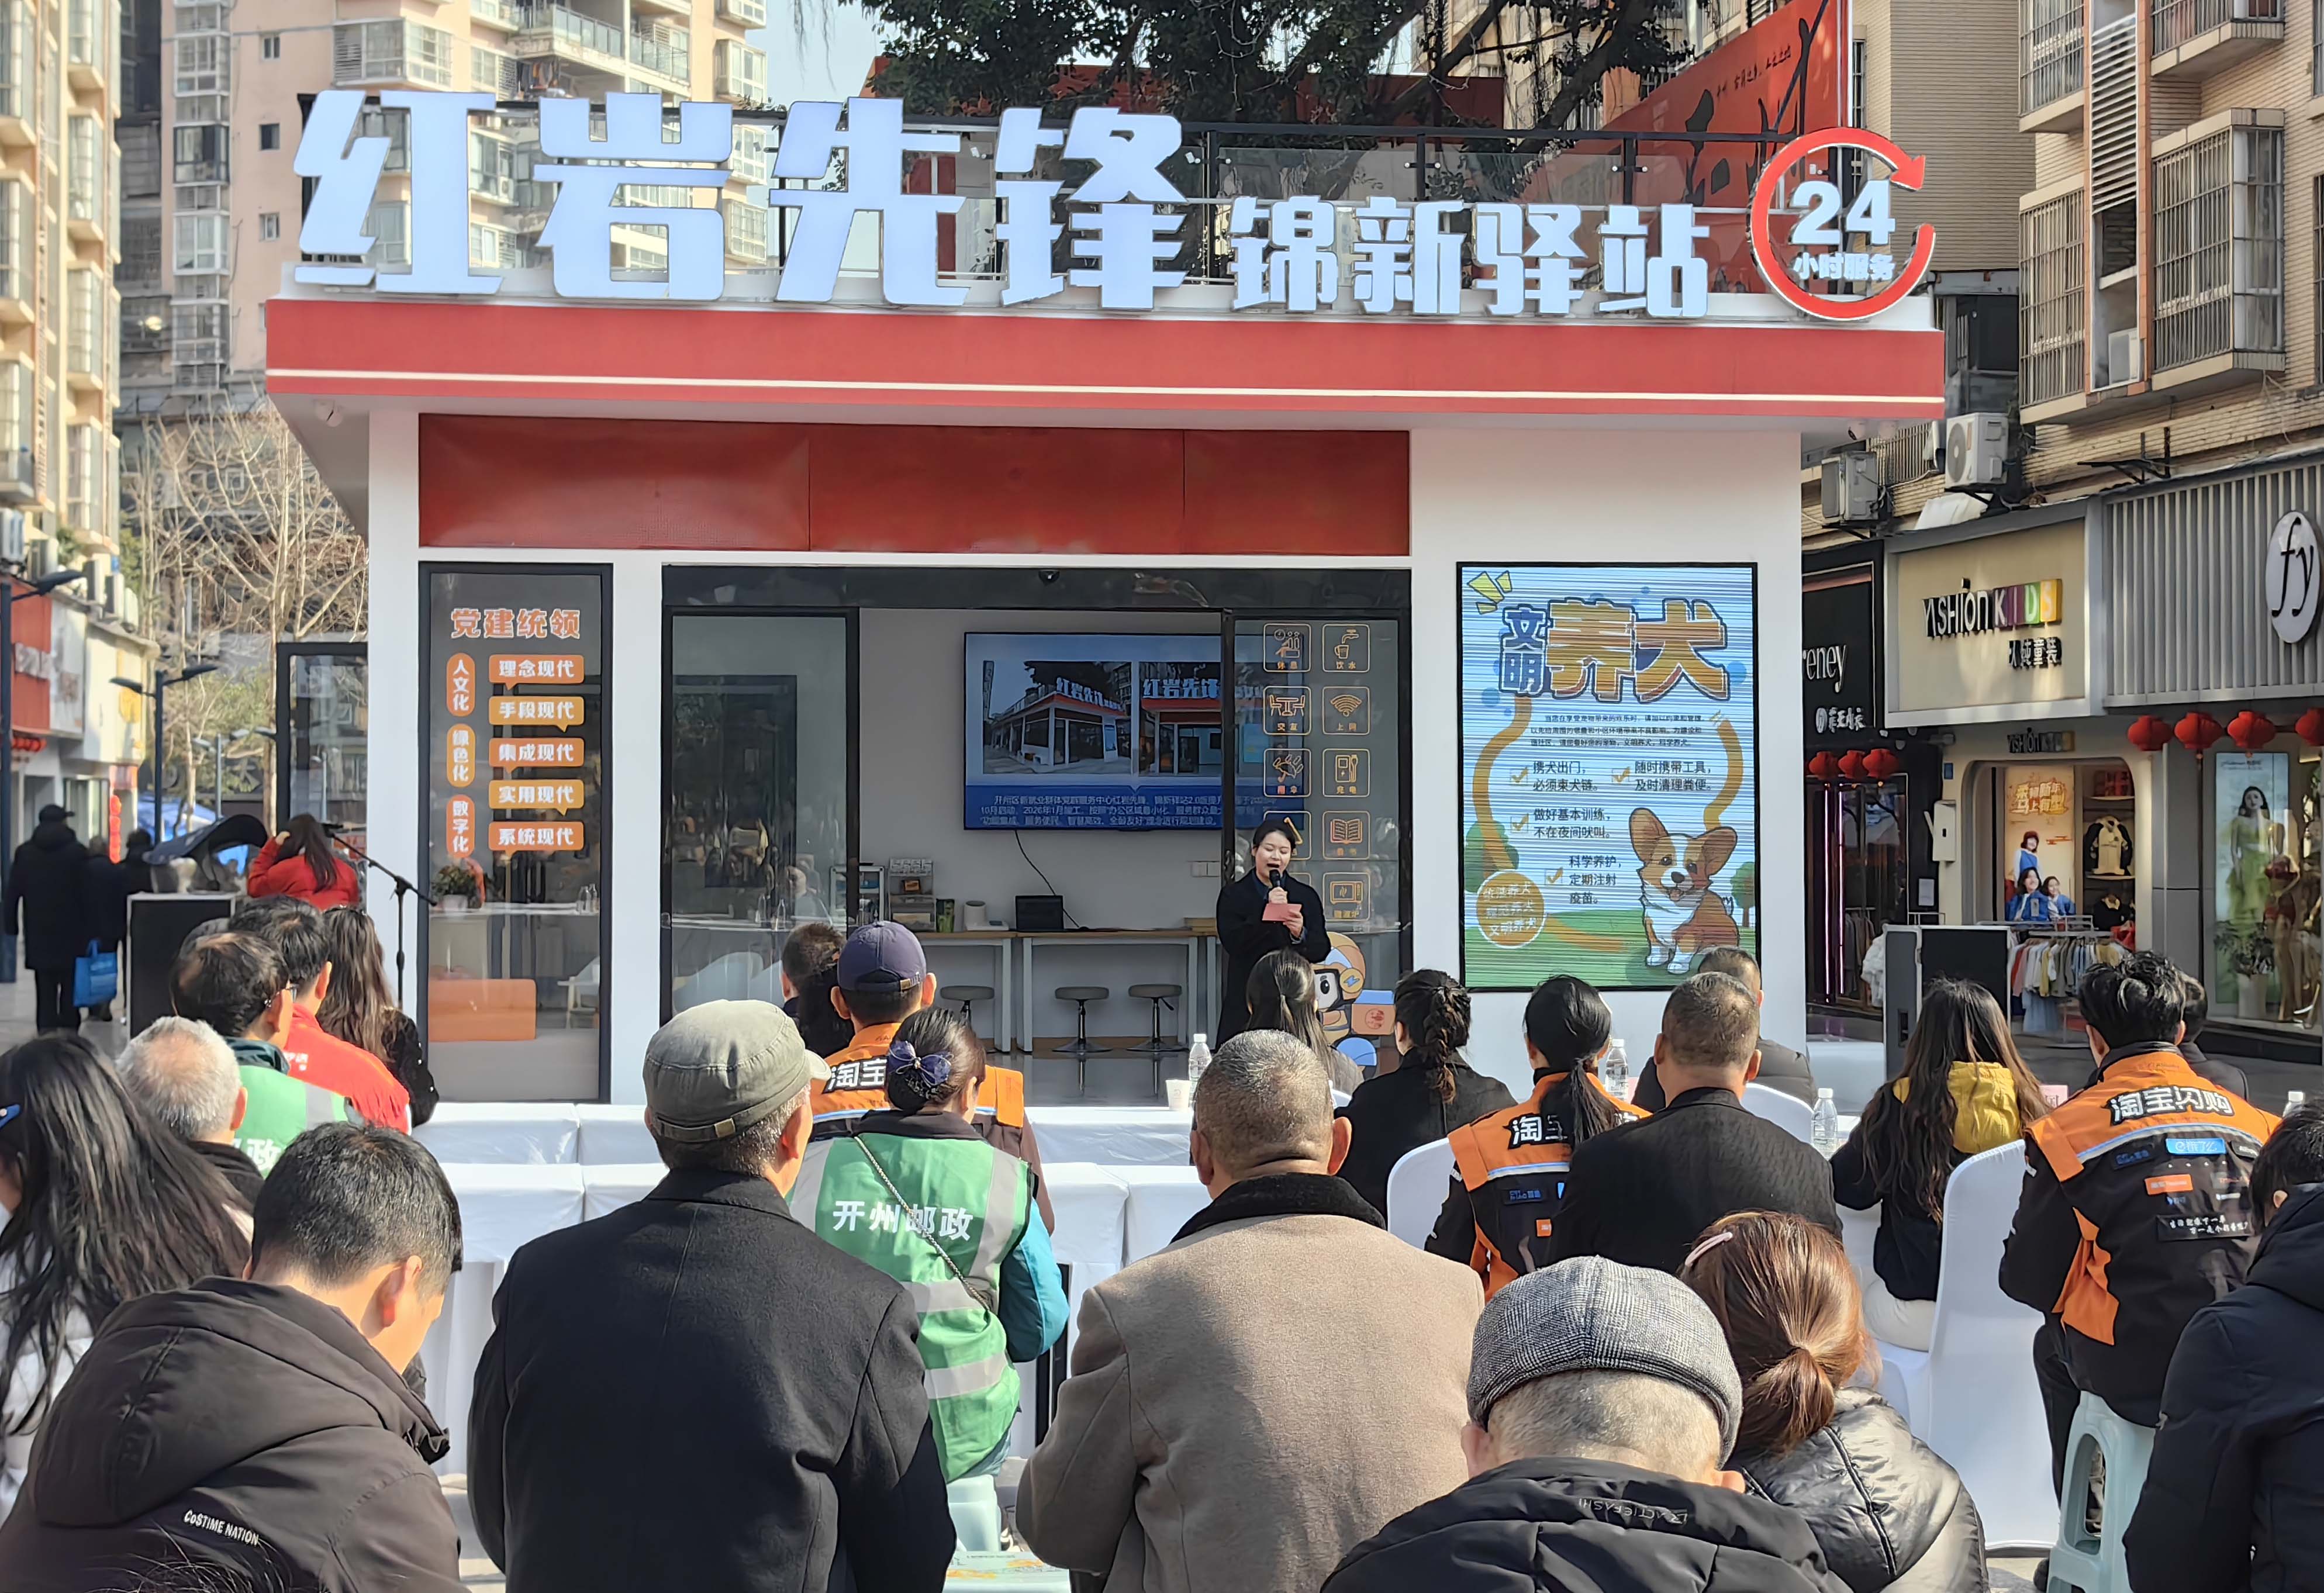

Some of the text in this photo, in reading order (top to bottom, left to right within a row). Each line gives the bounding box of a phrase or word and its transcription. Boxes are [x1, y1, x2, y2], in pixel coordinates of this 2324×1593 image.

[294, 89, 1711, 317] 红岩先锋 锦新驿站
[1790, 181, 1895, 246] 24
[1793, 253, 1894, 281] 小时服务
[1994, 580, 2060, 628] KIDS
[451, 609, 580, 638] 党建统领
[453, 660, 469, 711] 人文化
[499, 660, 575, 679] 理念现代
[499, 702, 575, 720] 手段现代
[453, 730, 469, 782] 绿色化
[498, 744, 574, 763] 集成现代
[498, 786, 574, 804] 实用现代
[452, 800, 469, 853] 数字化
[498, 828, 574, 846] 系统现代
[2111, 1086, 2235, 1121] 淘宝闪购
[833, 1200, 973, 1241] 开州邮政
[225, 1522, 259, 1546] NATION
